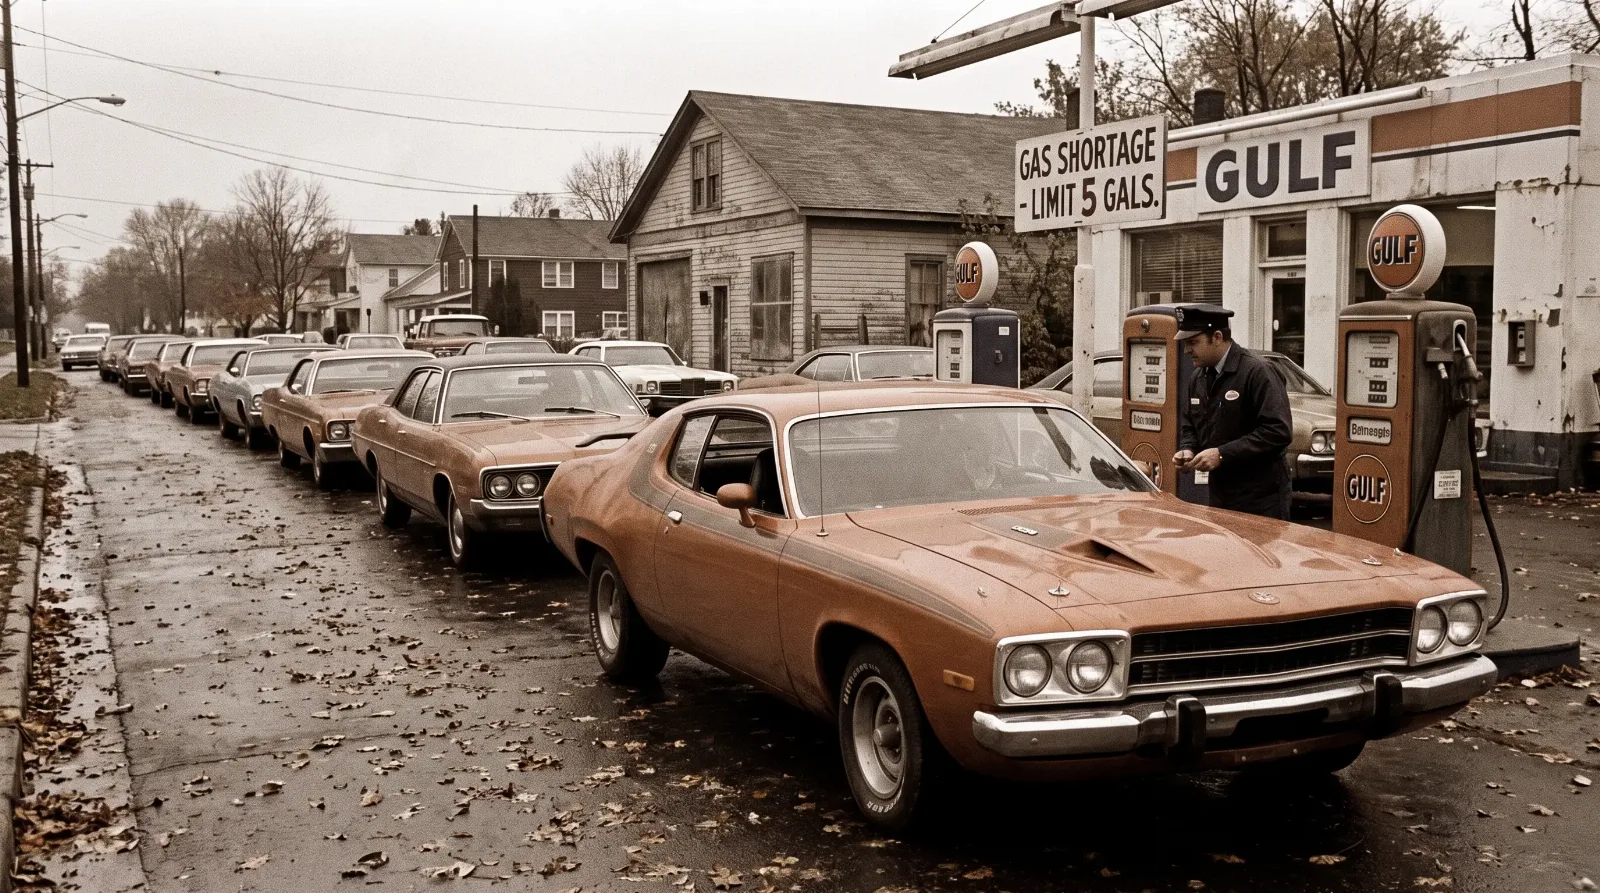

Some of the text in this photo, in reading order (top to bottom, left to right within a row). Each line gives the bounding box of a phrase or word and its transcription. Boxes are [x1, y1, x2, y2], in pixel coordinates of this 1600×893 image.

[1019, 126, 1157, 181] GAS SHORTAGE
[1205, 130, 1356, 203] GULF
[1081, 176, 1097, 217] 5
[1103, 172, 1160, 212] GALS.
[1371, 234, 1419, 266] GULF
[1347, 473, 1387, 505] GULF
